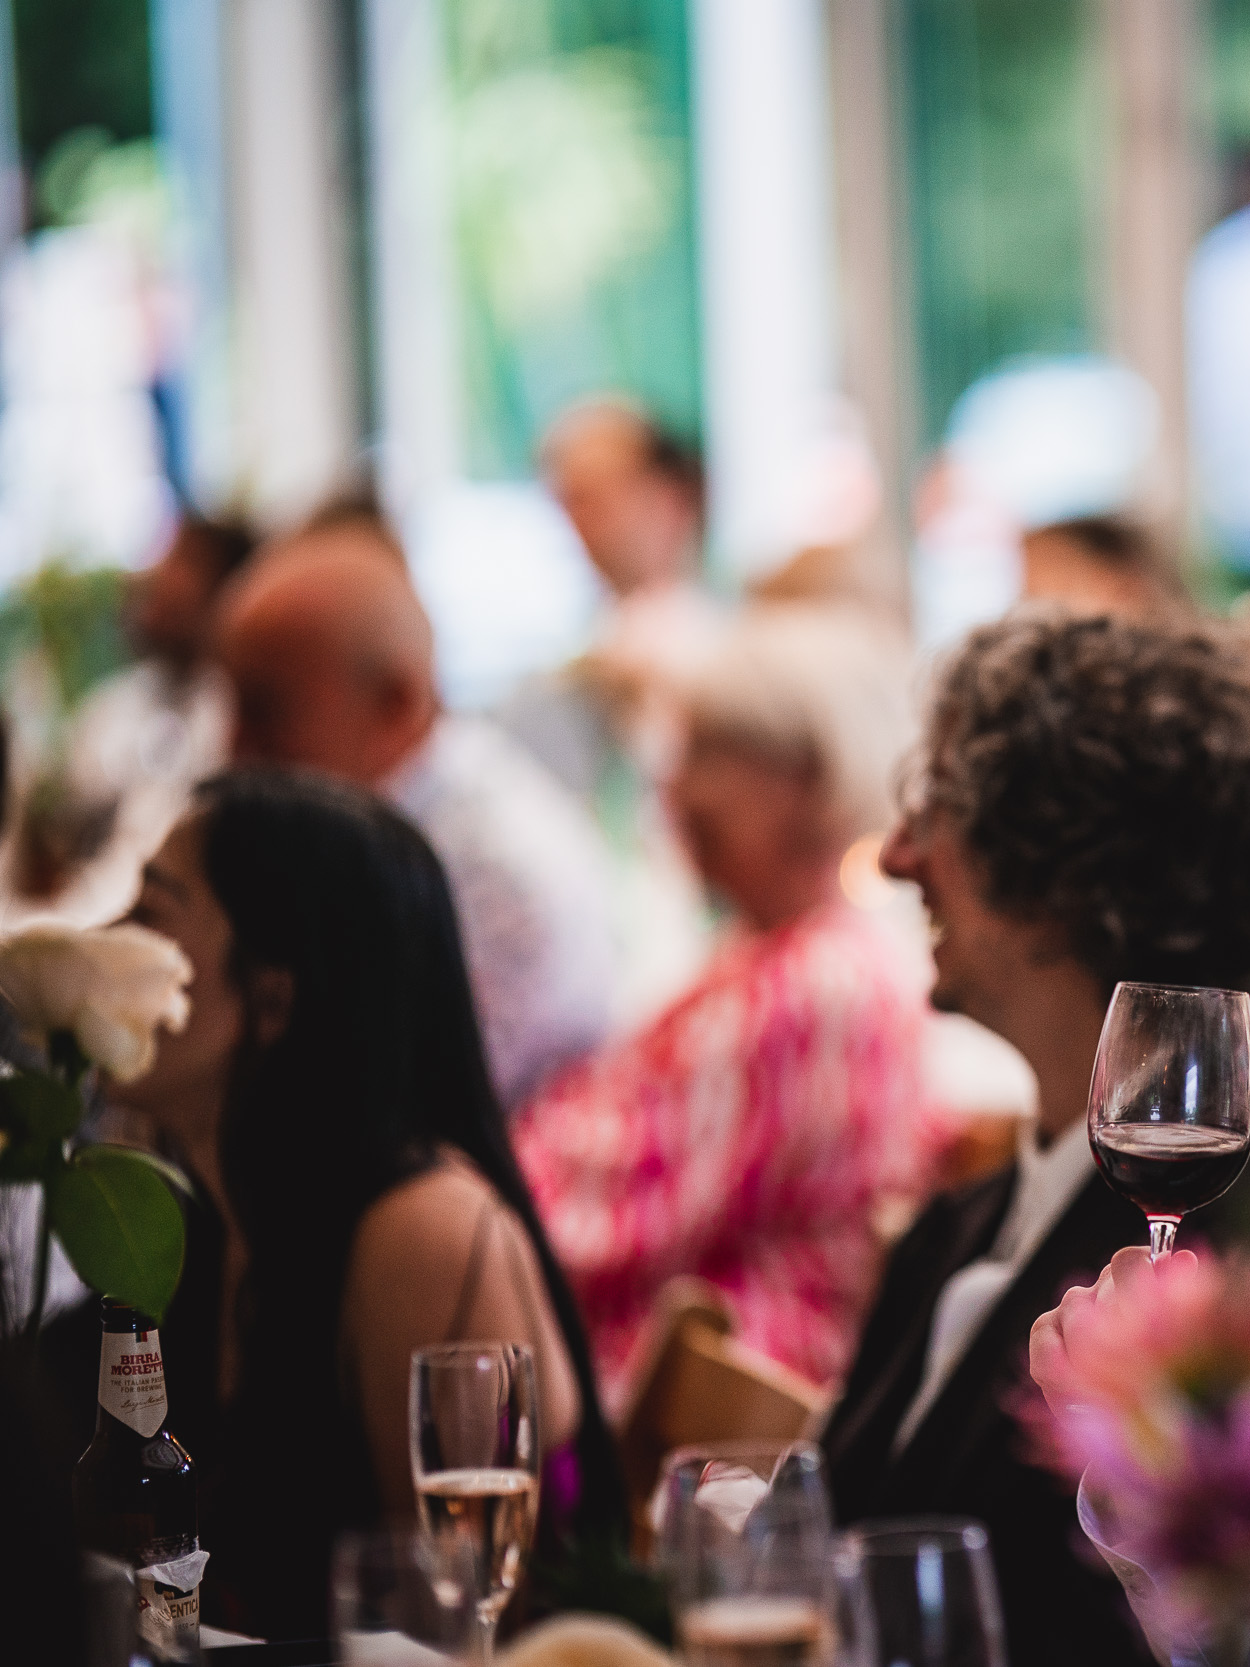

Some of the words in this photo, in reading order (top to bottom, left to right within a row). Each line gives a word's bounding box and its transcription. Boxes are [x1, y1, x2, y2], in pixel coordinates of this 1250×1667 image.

[120, 1352, 159, 1364] BIRRA
[111, 1361, 163, 1375] MORETT
[124, 1378, 150, 1386] ITALIAN
[137, 1384, 162, 1392] BREWING
